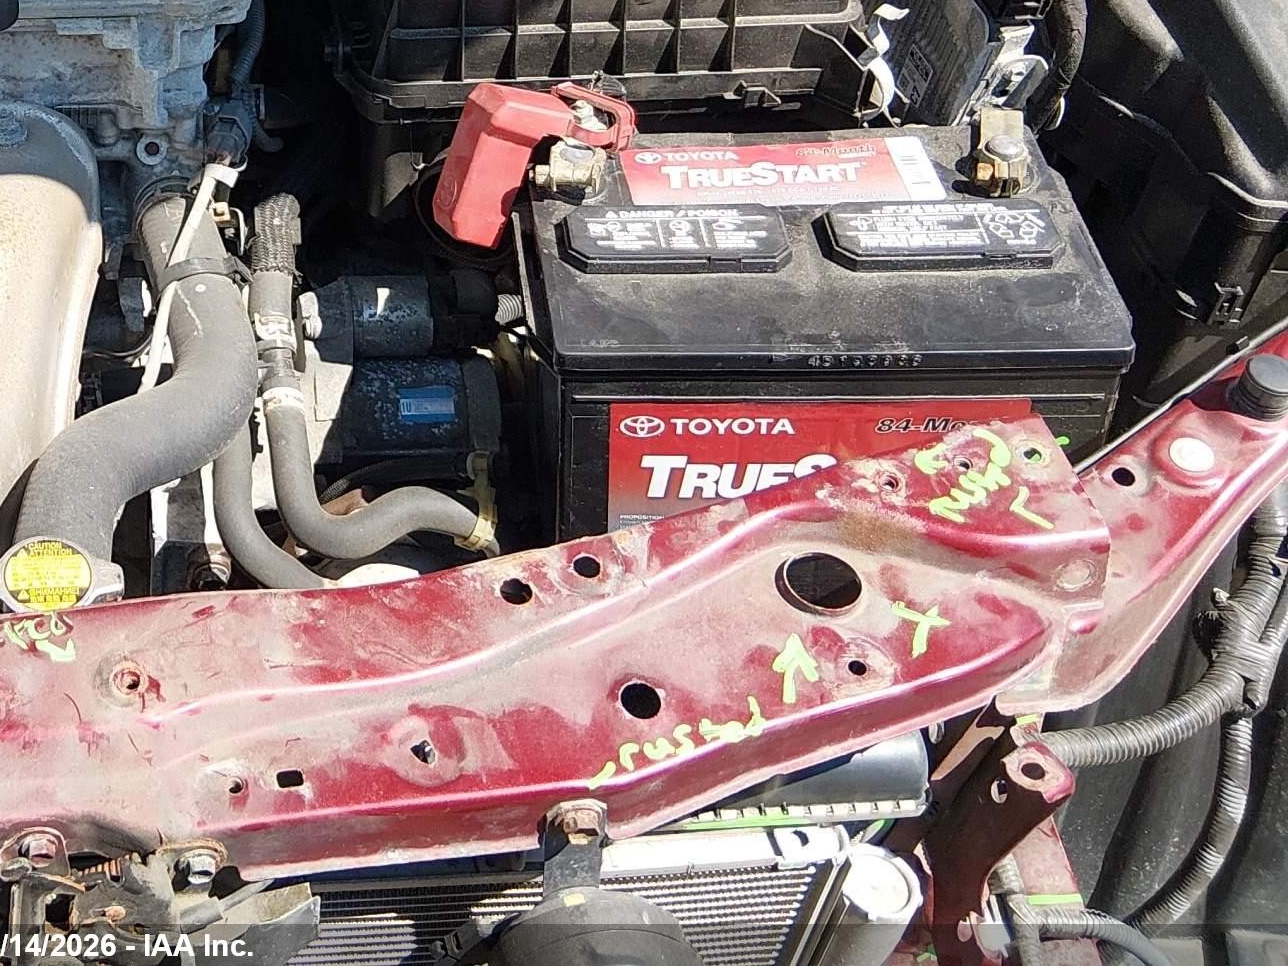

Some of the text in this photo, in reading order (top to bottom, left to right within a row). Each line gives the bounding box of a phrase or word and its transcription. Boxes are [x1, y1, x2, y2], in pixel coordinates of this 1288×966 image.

[664, 150, 739, 163] TOYOTA
[620, 210, 675, 218] DANGER
[687, 208, 739, 217] POISON
[672, 417, 795, 436] TOYOTA
[875, 417, 968, 434] 84-Mo
[28, 541, 62, 549] CAUTION
[29, 548, 73, 556] ATTENTION
